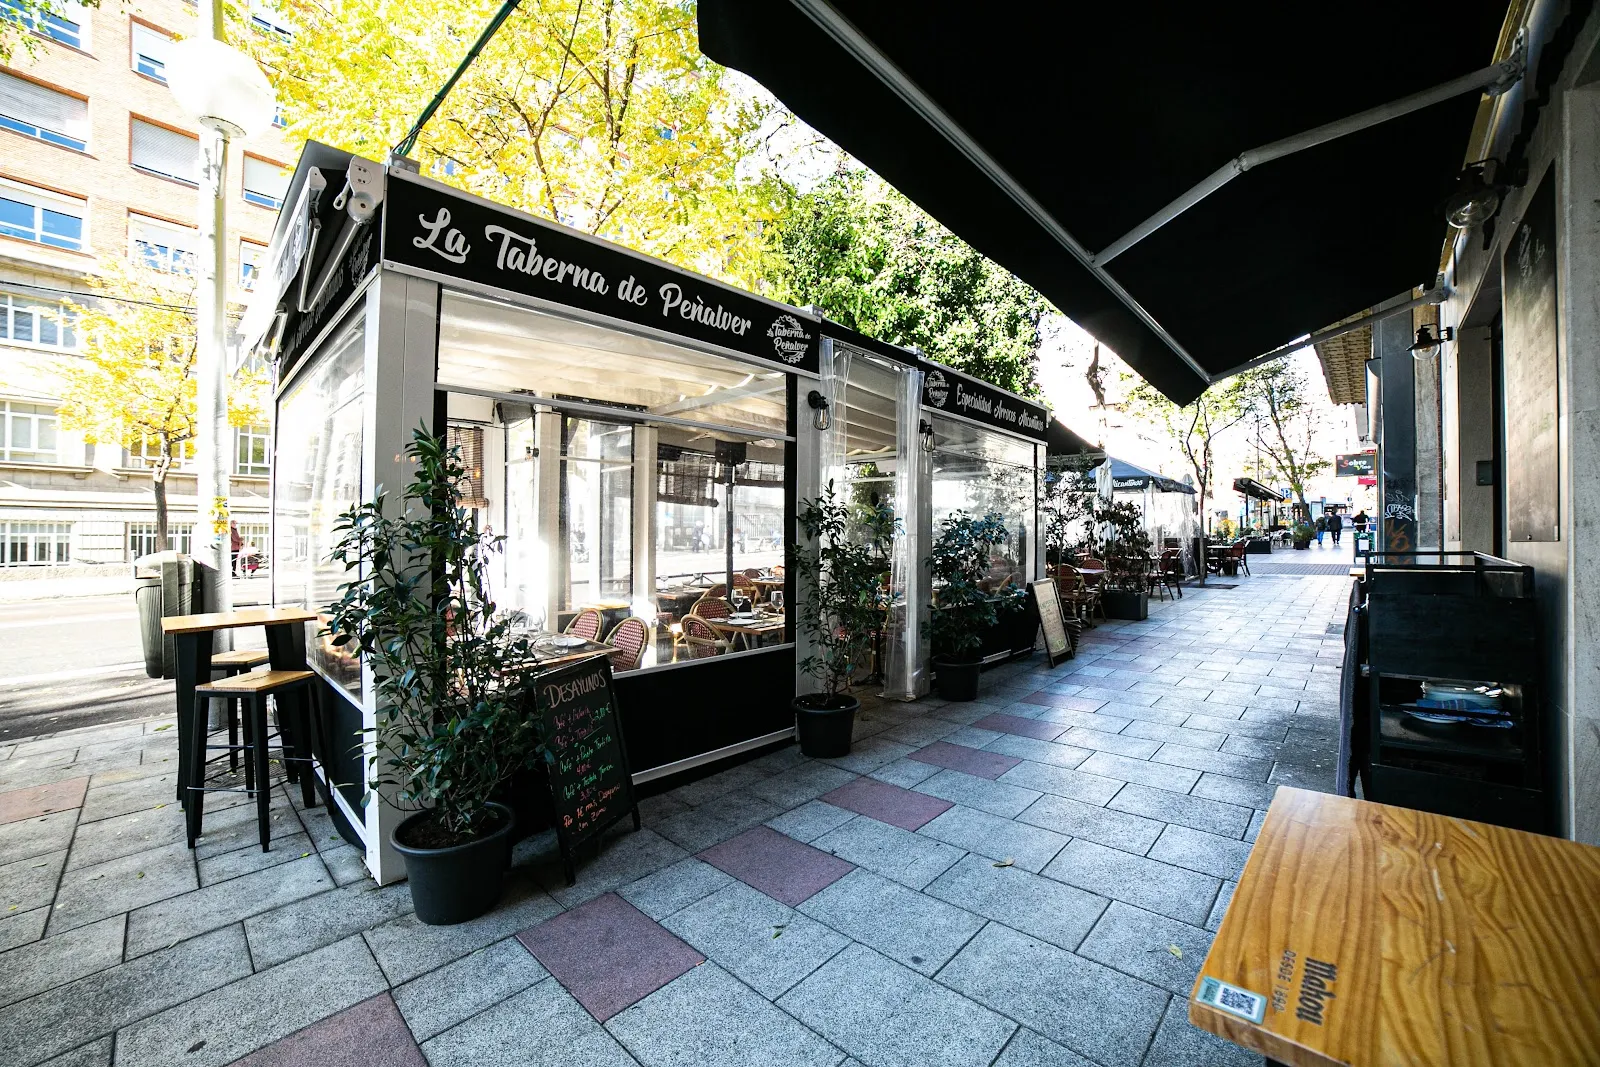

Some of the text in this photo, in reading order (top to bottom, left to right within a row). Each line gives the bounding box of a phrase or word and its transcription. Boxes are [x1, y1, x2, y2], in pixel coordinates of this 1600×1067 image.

[413, 207, 471, 264] La
[485, 225, 609, 295] Taberna
[617, 275, 648, 306] de
[659, 283, 752, 336] Peñalver
[772, 323, 804, 338] Taberna
[774, 337, 808, 351] Peñalver
[957, 383, 991, 414] Especialidad
[994, 400, 1016, 422] Arroces
[543, 669, 606, 708] DESAYUNOS
[1296, 957, 1338, 1026] Mahou
